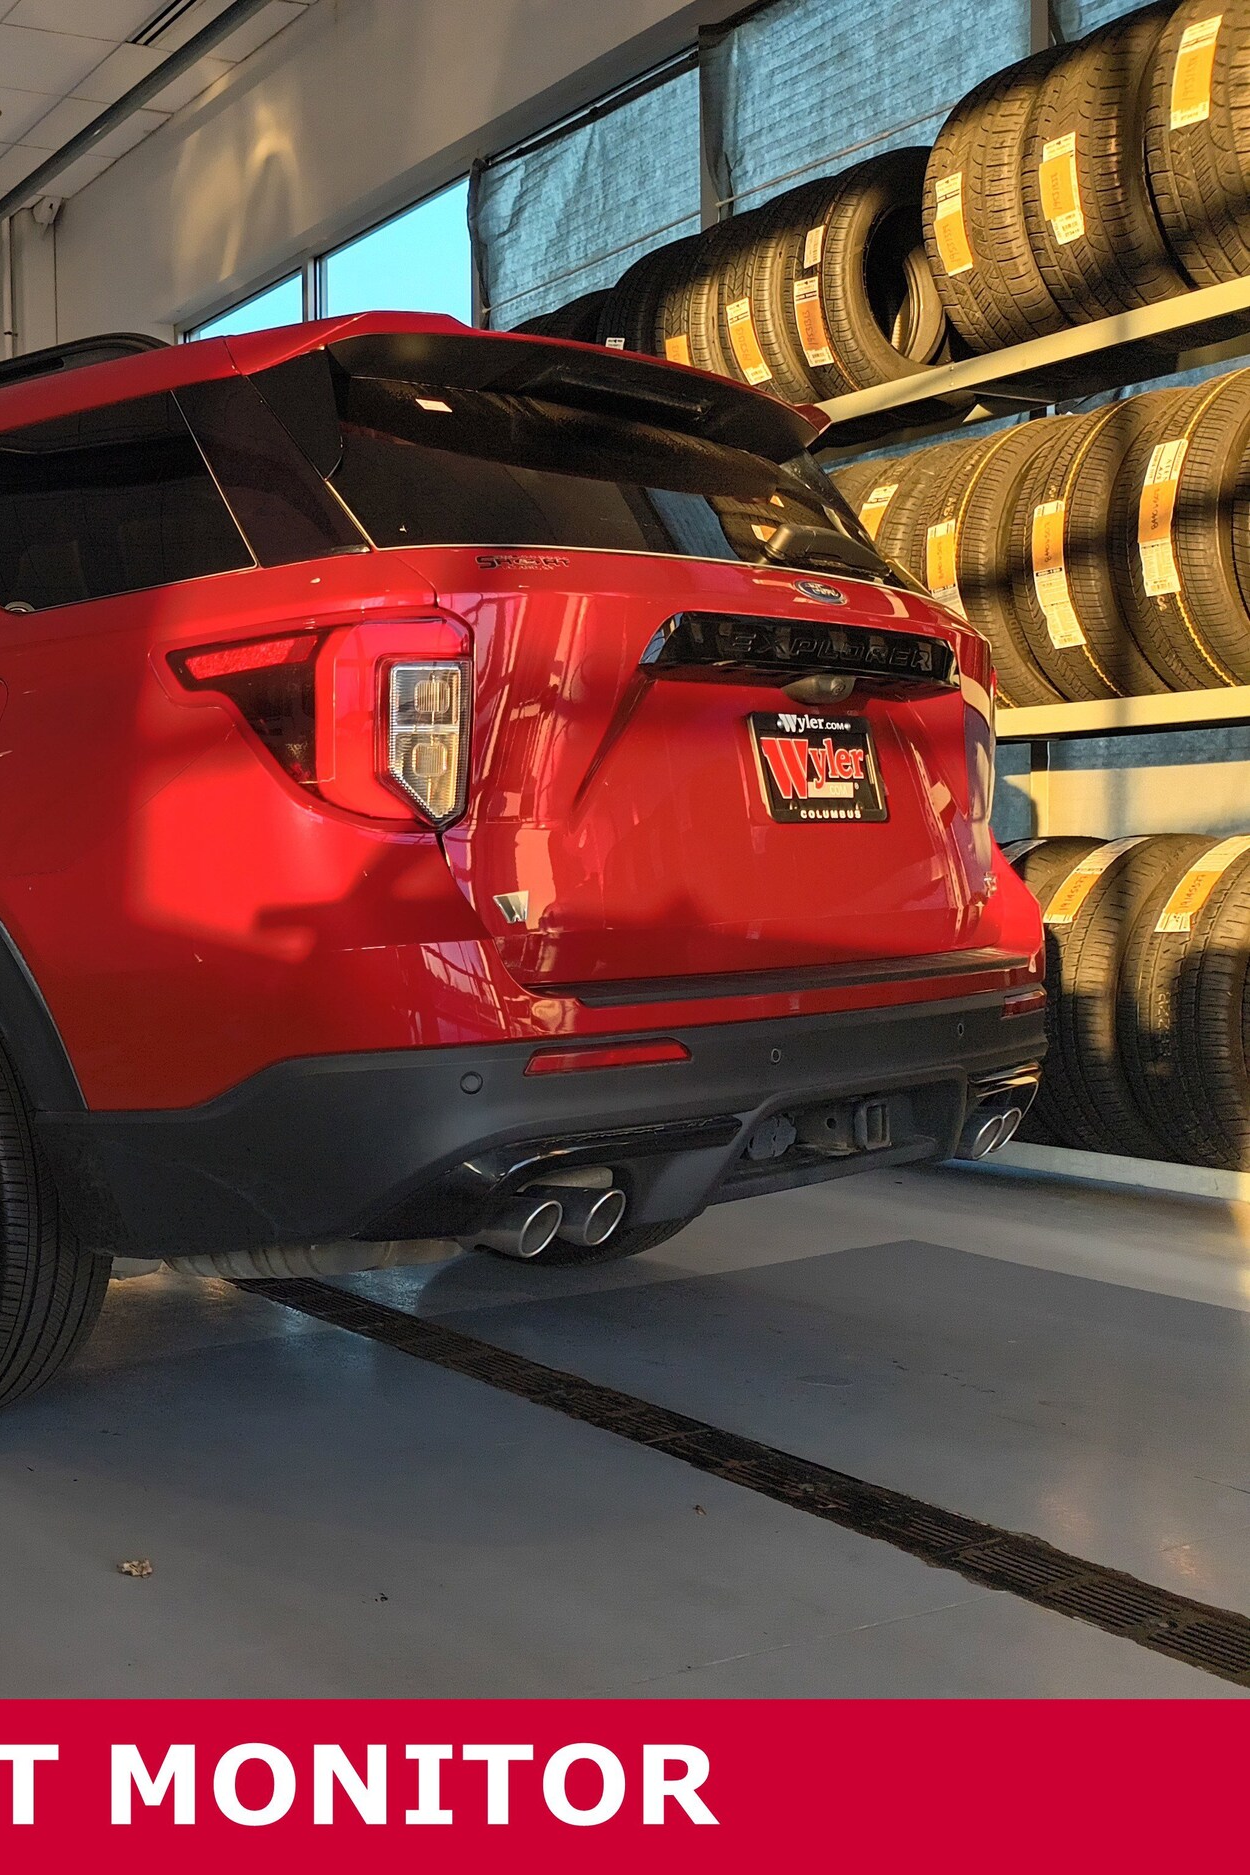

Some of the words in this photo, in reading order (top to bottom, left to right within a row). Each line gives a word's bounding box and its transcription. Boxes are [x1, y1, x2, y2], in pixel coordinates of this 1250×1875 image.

[732, 632, 933, 671] EXPLORER
[760, 736, 865, 800] Wyler
[800, 809, 862, 819] COLUMBUS
